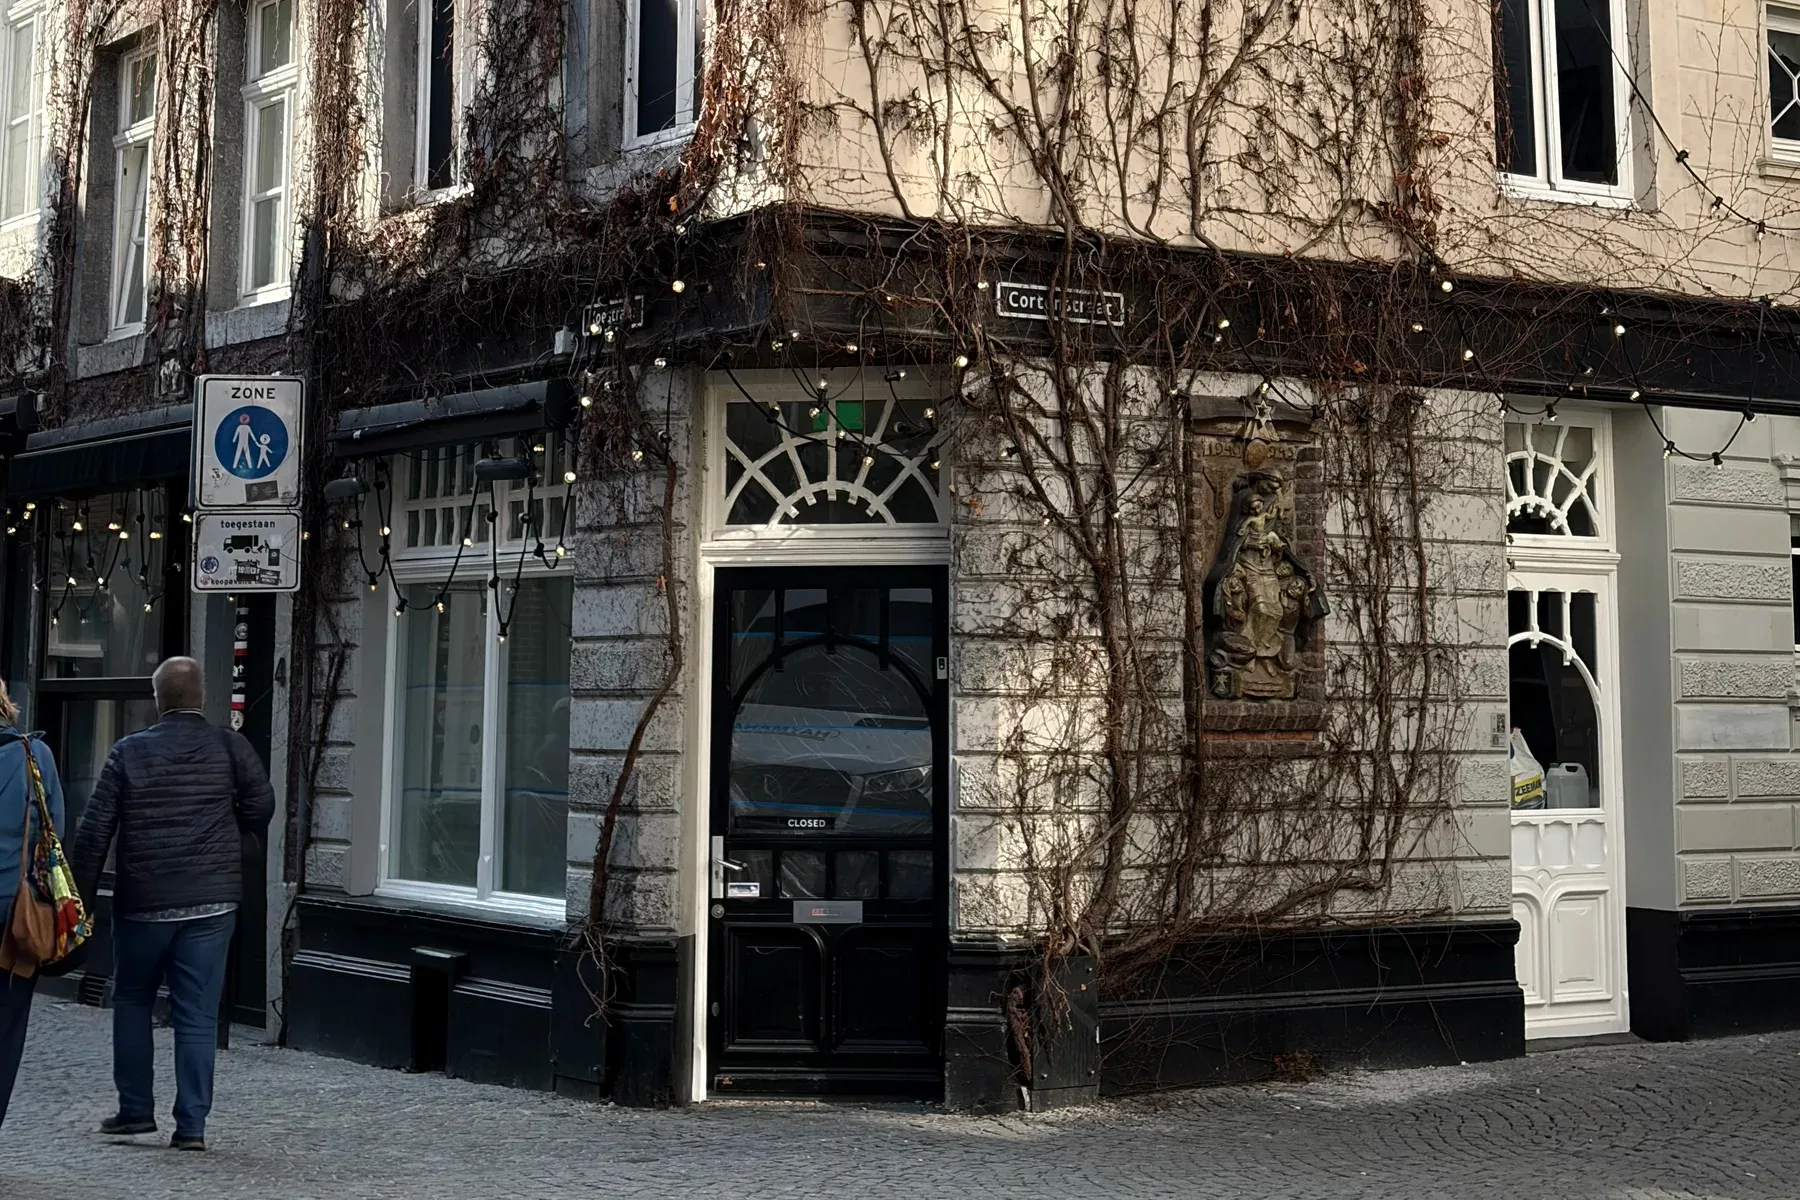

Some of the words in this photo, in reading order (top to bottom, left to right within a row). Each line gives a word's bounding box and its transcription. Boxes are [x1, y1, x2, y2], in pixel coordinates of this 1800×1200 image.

[231, 387, 276, 400] ZONE
[220, 519, 276, 531] toegestaan
[274, 657, 287, 688] 4
[787, 818, 827, 829] CLOSED
